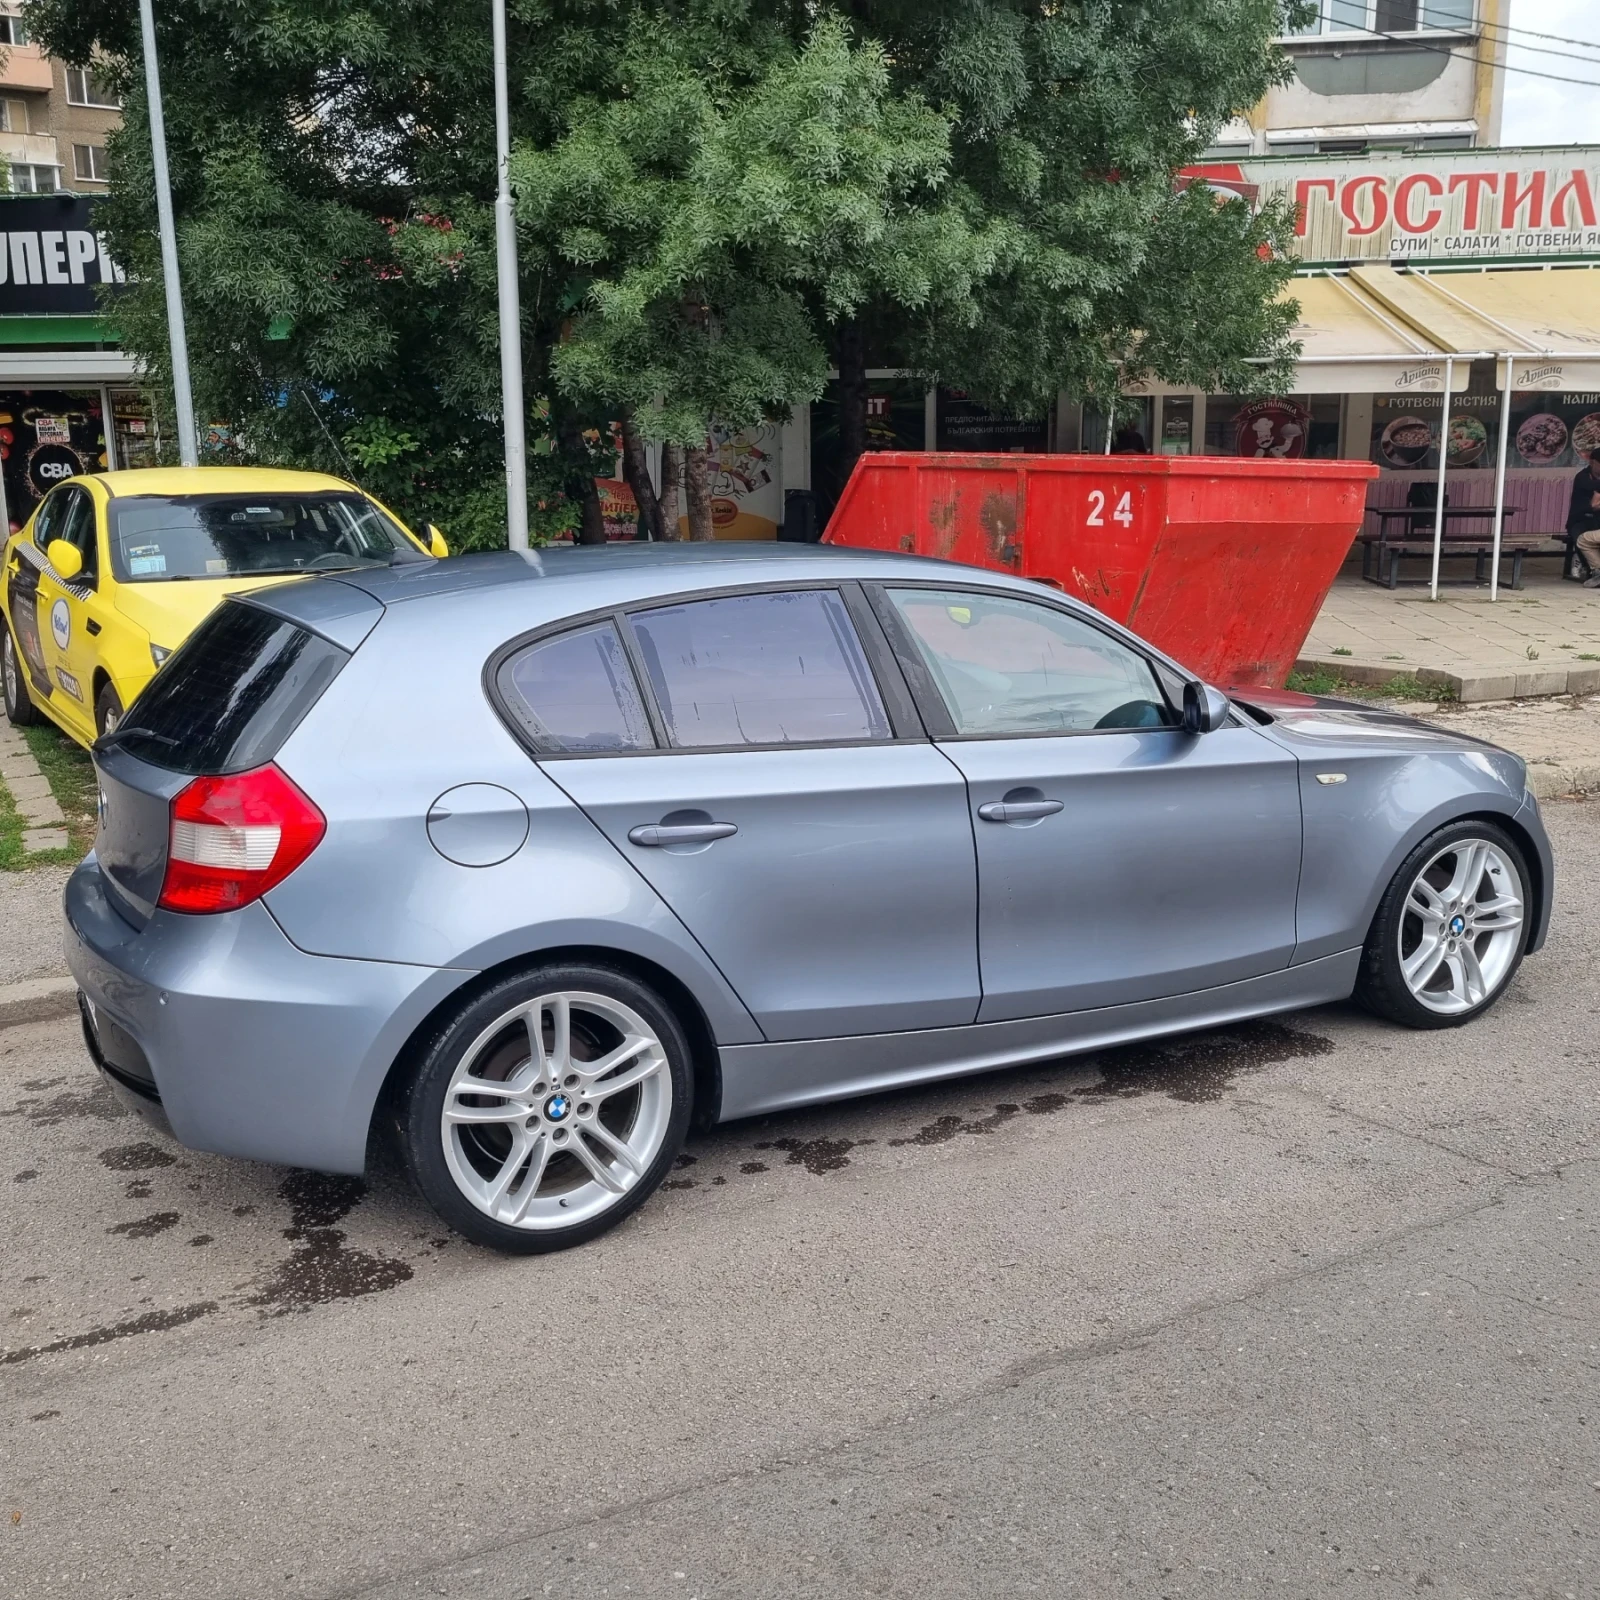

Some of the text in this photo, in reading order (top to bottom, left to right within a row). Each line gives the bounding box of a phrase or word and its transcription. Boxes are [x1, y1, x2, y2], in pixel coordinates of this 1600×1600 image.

[1390, 238, 1428, 251] СУПИ
[1444, 235, 1500, 249] САЛАТИ
[1516, 232, 1582, 248] ГОТВЕНИ
[1518, 366, 1564, 386] Ариана
[1453, 395, 1497, 407] ЯСТИЯ
[1562, 393, 1600, 405] НАПИ
[39, 462, 74, 478] CBA
